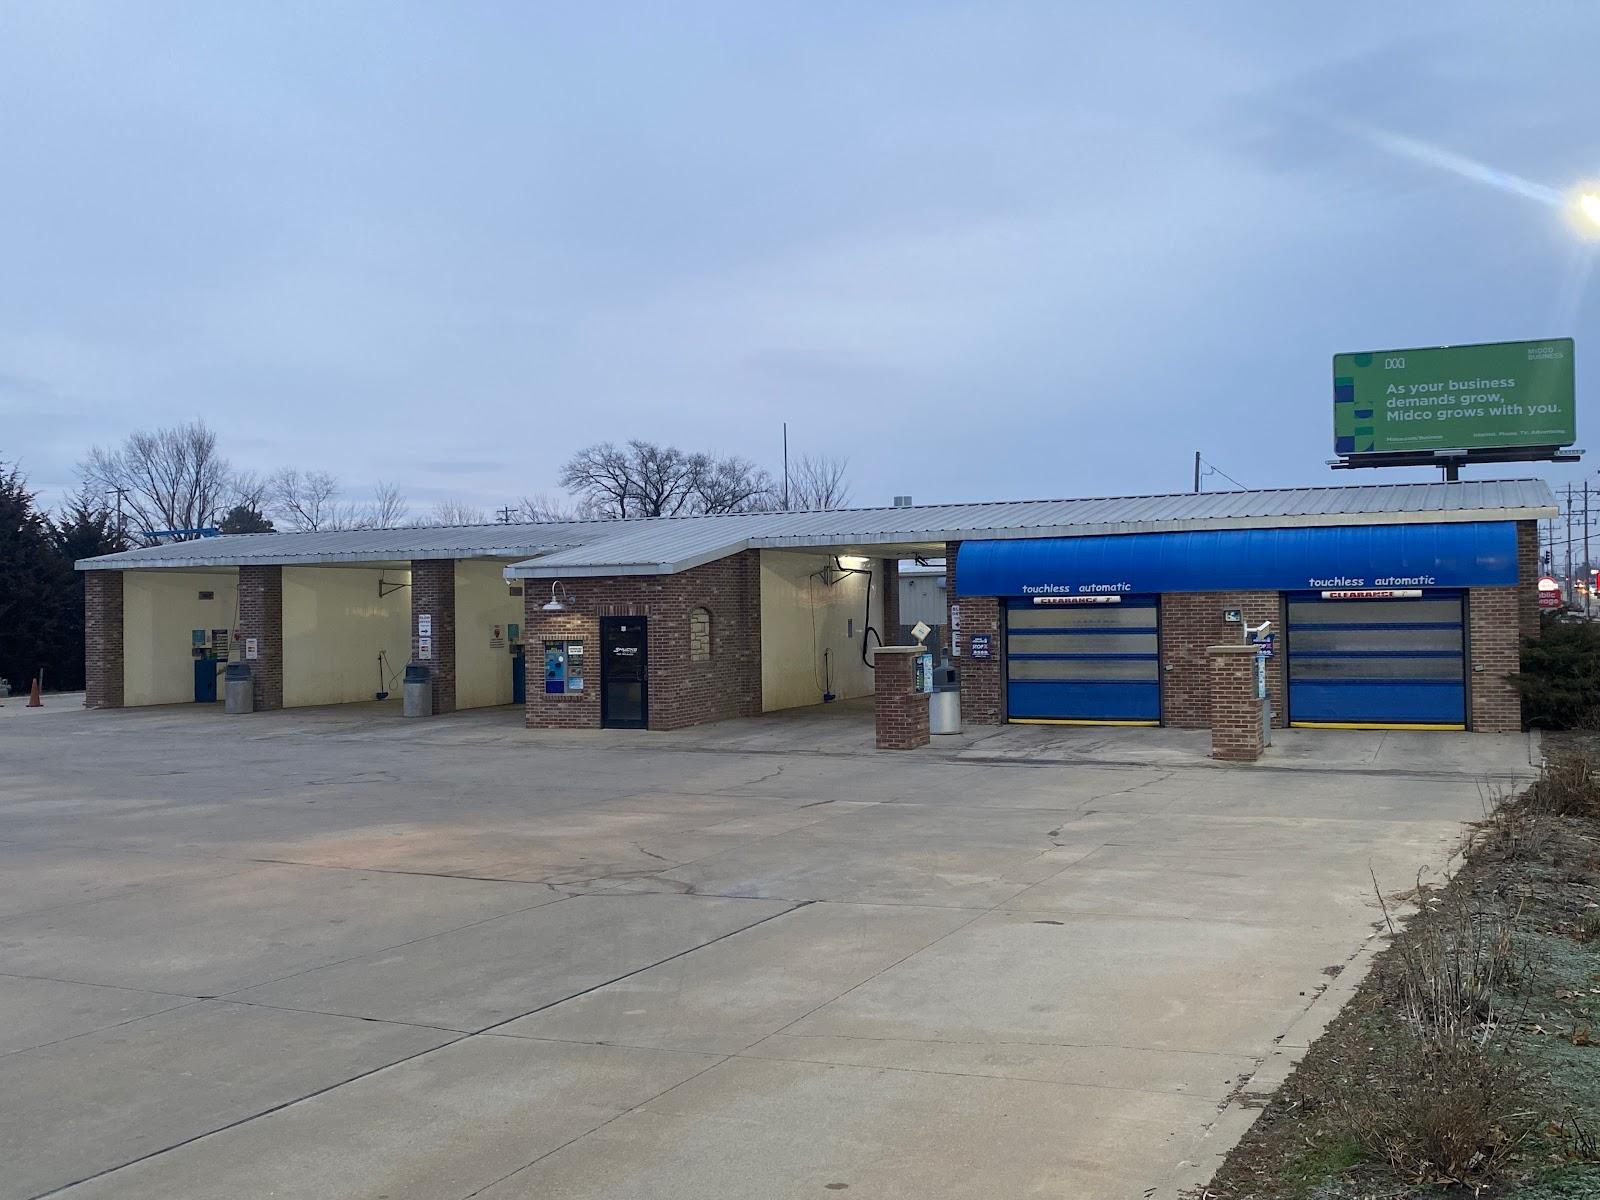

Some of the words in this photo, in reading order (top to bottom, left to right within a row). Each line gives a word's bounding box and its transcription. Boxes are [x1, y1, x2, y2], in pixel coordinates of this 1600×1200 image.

[1386, 384, 1405, 394] As
[1410, 383, 1445, 397] your
[1449, 377, 1515, 391] business
[1386, 395, 1455, 408] demands
[1460, 392, 1505, 408] grow,
[1387, 409, 1432, 422] Midco
[1437, 407, 1485, 421] grows
[1489, 404, 1523, 416] with
[1527, 403, 1562, 416] you.
[1022, 584, 1070, 593] touchless
[1079, 582, 1131, 592] automatic
[1309, 576, 1364, 587] touchless
[1375, 575, 1435, 586] automatic
